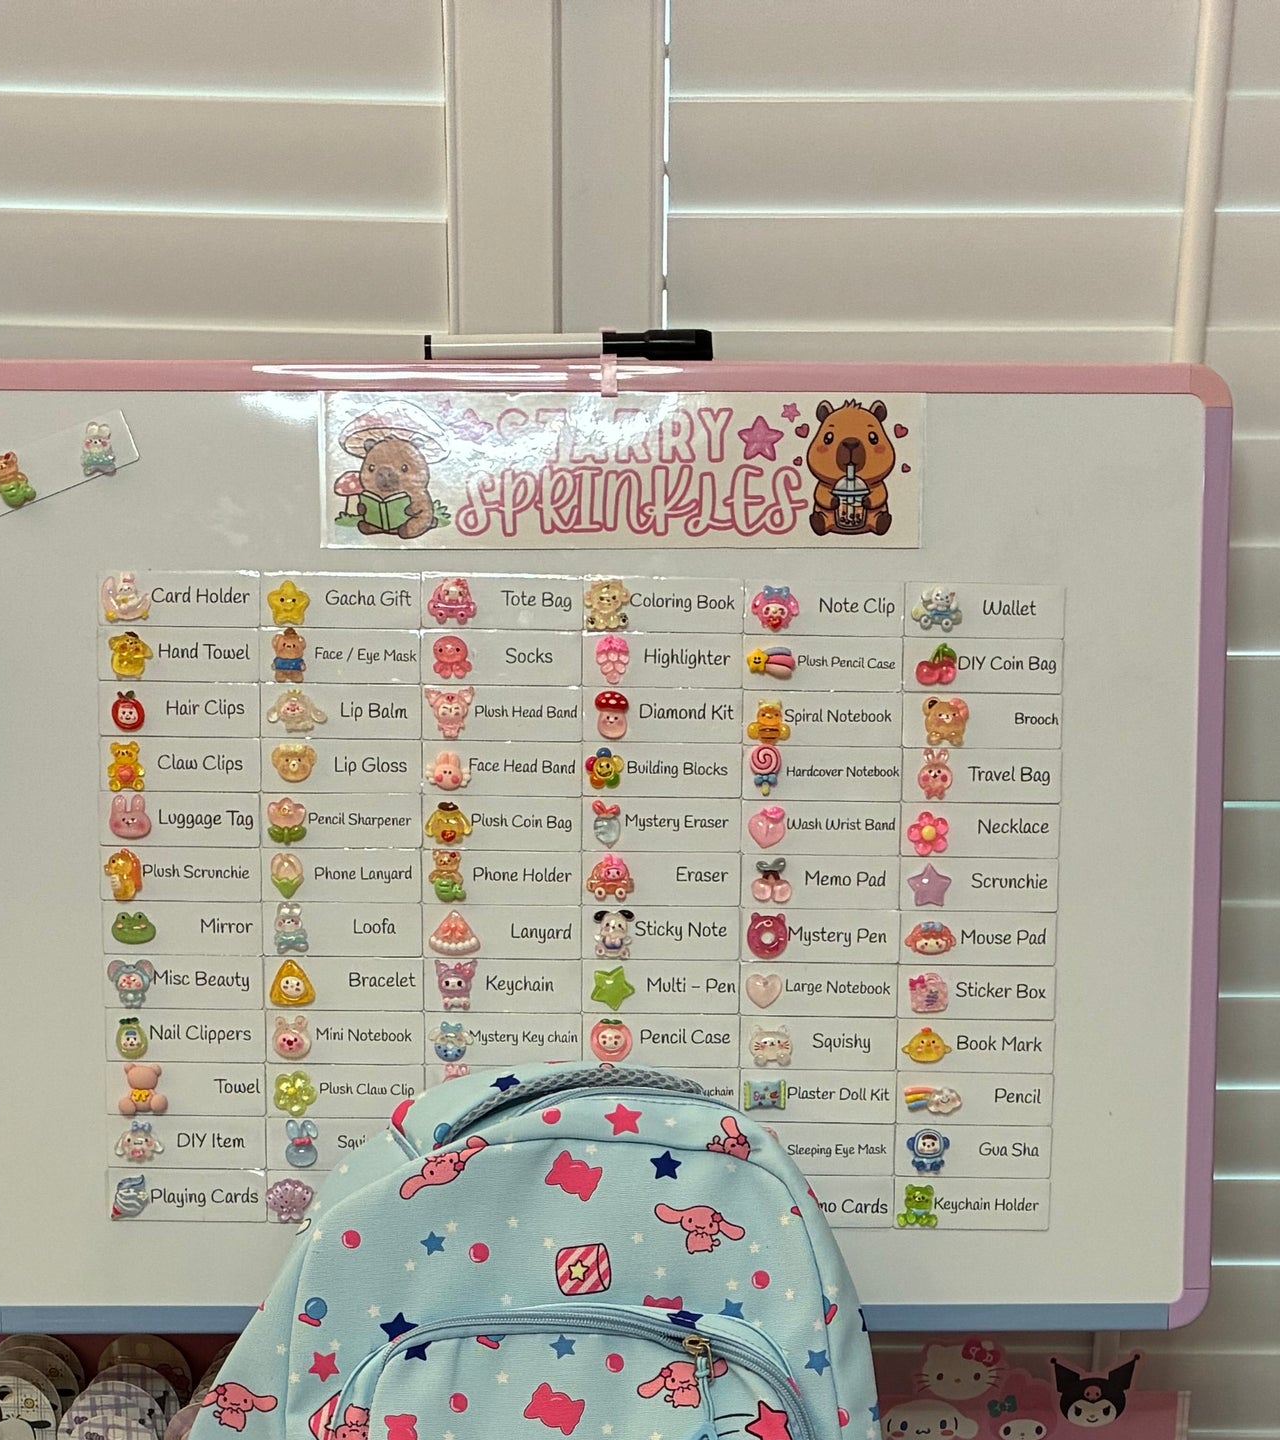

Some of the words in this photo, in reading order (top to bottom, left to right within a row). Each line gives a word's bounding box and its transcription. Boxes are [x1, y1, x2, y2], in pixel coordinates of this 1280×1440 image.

[455, 465, 809, 537] SPRINKLES
[151, 586, 191, 603] Card
[197, 586, 250, 603] Holder
[326, 590, 376, 606] Gacha
[380, 590, 411, 606] Gift
[501, 590, 536, 606] Tote
[542, 592, 572, 612] Bag
[629, 593, 692, 613] Coloring
[697, 595, 735, 610] Book
[820, 597, 859, 613] Note
[864, 597, 895, 617] Clip
[983, 600, 1036, 616] Wallet
[159, 642, 198, 659] Hand
[204, 644, 250, 660] Towel
[506, 648, 553, 664] Socks
[644, 648, 731, 669] Highlighter
[341, 701, 363, 721] Lip
[369, 702, 408, 719] Balm
[475, 705, 508, 718] Plush
[512, 705, 543, 718] Head
[547, 705, 578, 718] Band
[640, 703, 706, 719] Diamond
[712, 704, 734, 720] Kit
[1015, 712, 1059, 725] Brooch
[787, 765, 844, 777] Hardcover
[847, 766, 899, 777] Notebook
[159, 809, 222, 829] Luggage
[226, 810, 253, 830] Tag
[308, 812, 345, 824] Pencil
[349, 813, 412, 828] Sharpener
[978, 818, 1049, 834] Necklace
[315, 866, 356, 880] Phone
[361, 865, 412, 884] Lanyard
[677, 867, 728, 882] Eraser
[805, 870, 851, 886] Memo
[857, 870, 886, 887] Pad
[971, 873, 1048, 889] Scrunchie
[201, 918, 253, 933] Mirror
[354, 918, 396, 934] Loofa
[511, 923, 572, 944] Lanyard
[635, 920, 682, 941] Sticky
[688, 922, 727, 937] Note
[349, 972, 416, 987] Bracelet
[486, 975, 554, 995] Keychain
[956, 982, 1012, 998] Sticker
[1017, 984, 1046, 999] Box
[150, 1024, 181, 1040] Nail
[186, 1025, 251, 1044] Clippers
[813, 1033, 870, 1053] Squishy
[214, 1078, 261, 1095] Towel
[995, 1088, 1041, 1104] Pencil
[177, 1132, 207, 1148] DIY
[212, 1132, 246, 1149] Item
[979, 1142, 1008, 1156] Gua
[1013, 1143, 1039, 1157] Sha
[150, 1187, 207, 1208] Playing
[211, 1186, 259, 1204] Cards
